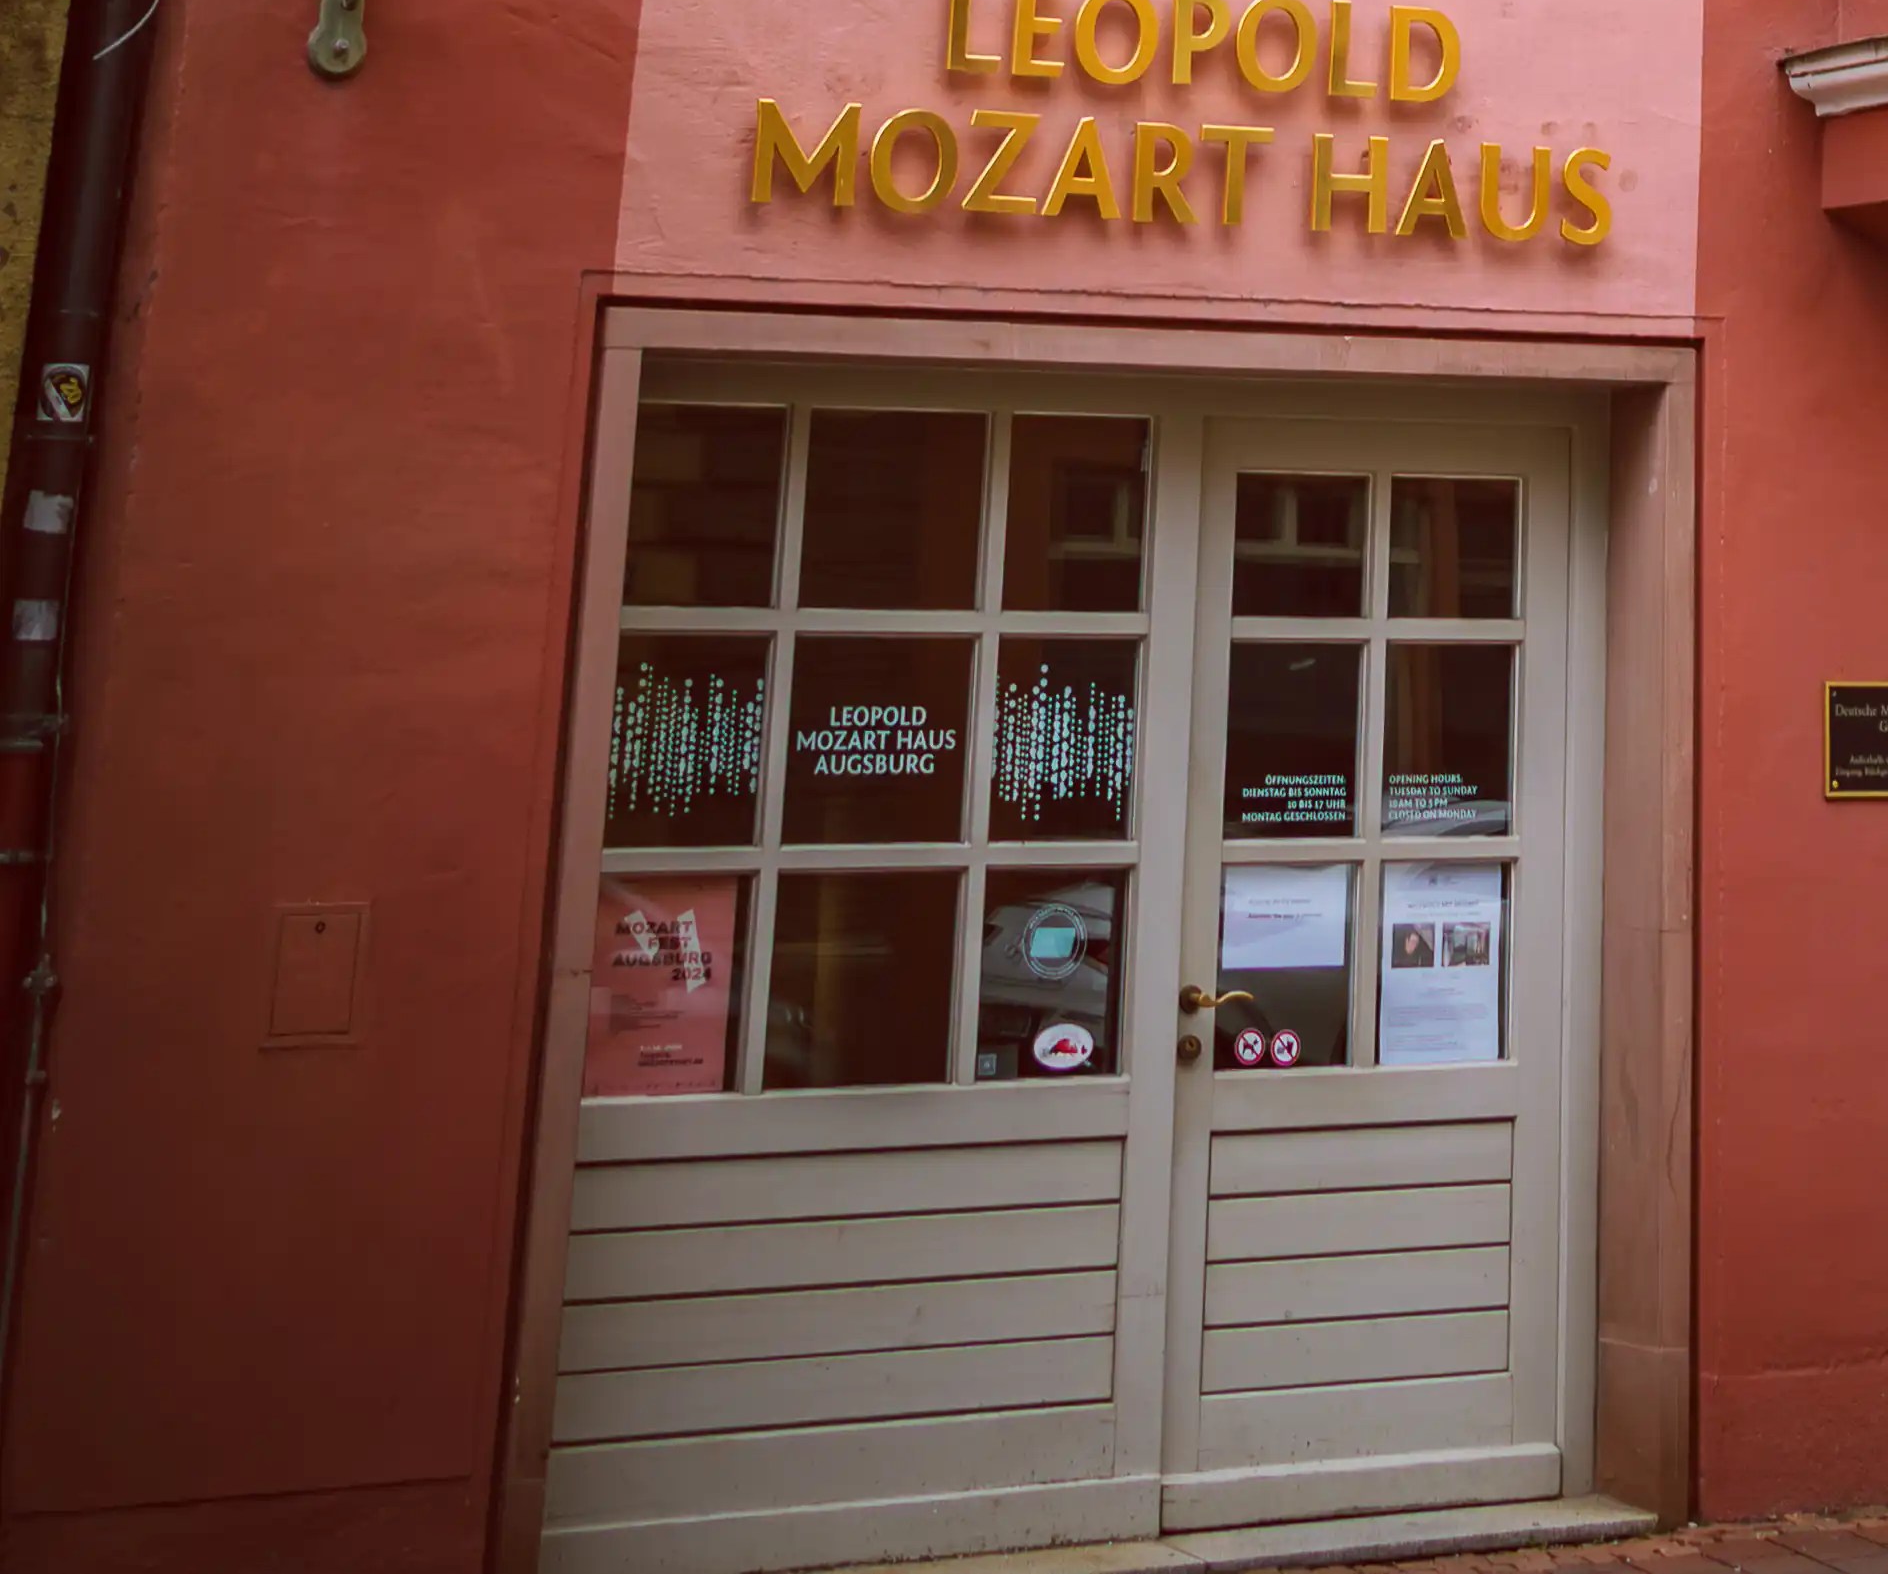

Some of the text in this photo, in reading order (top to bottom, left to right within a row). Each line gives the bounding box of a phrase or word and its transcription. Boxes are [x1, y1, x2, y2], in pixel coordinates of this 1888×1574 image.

[750, 96, 1613, 247] MOZART HAUS
[830, 706, 927, 727] LEOPOLD
[1835, 703, 1877, 717] Deutsche
[796, 729, 957, 752] MOZART HAUS
[814, 753, 935, 775] AUGSBURG
[1389, 774, 1429, 784] OPENING
[1242, 787, 1346, 798] DIENSTAG BIS SONNTAG
[1389, 785, 1478, 796] TUESDAY TO SUNDAY
[1298, 800, 1312, 809] BIS
[1326, 799, 1346, 809] UHR
[1415, 798, 1426, 808] TO
[1242, 811, 1346, 822] MONTAG GESCHLOSSEN
[1423, 810, 1437, 820] ON
[1438, 809, 1477, 820] MONDAY
[615, 920, 692, 935] MOZART
[648, 936, 691, 950] FEST
[612, 951, 712, 967] AUGSBURG
[672, 967, 711, 981] 2024
